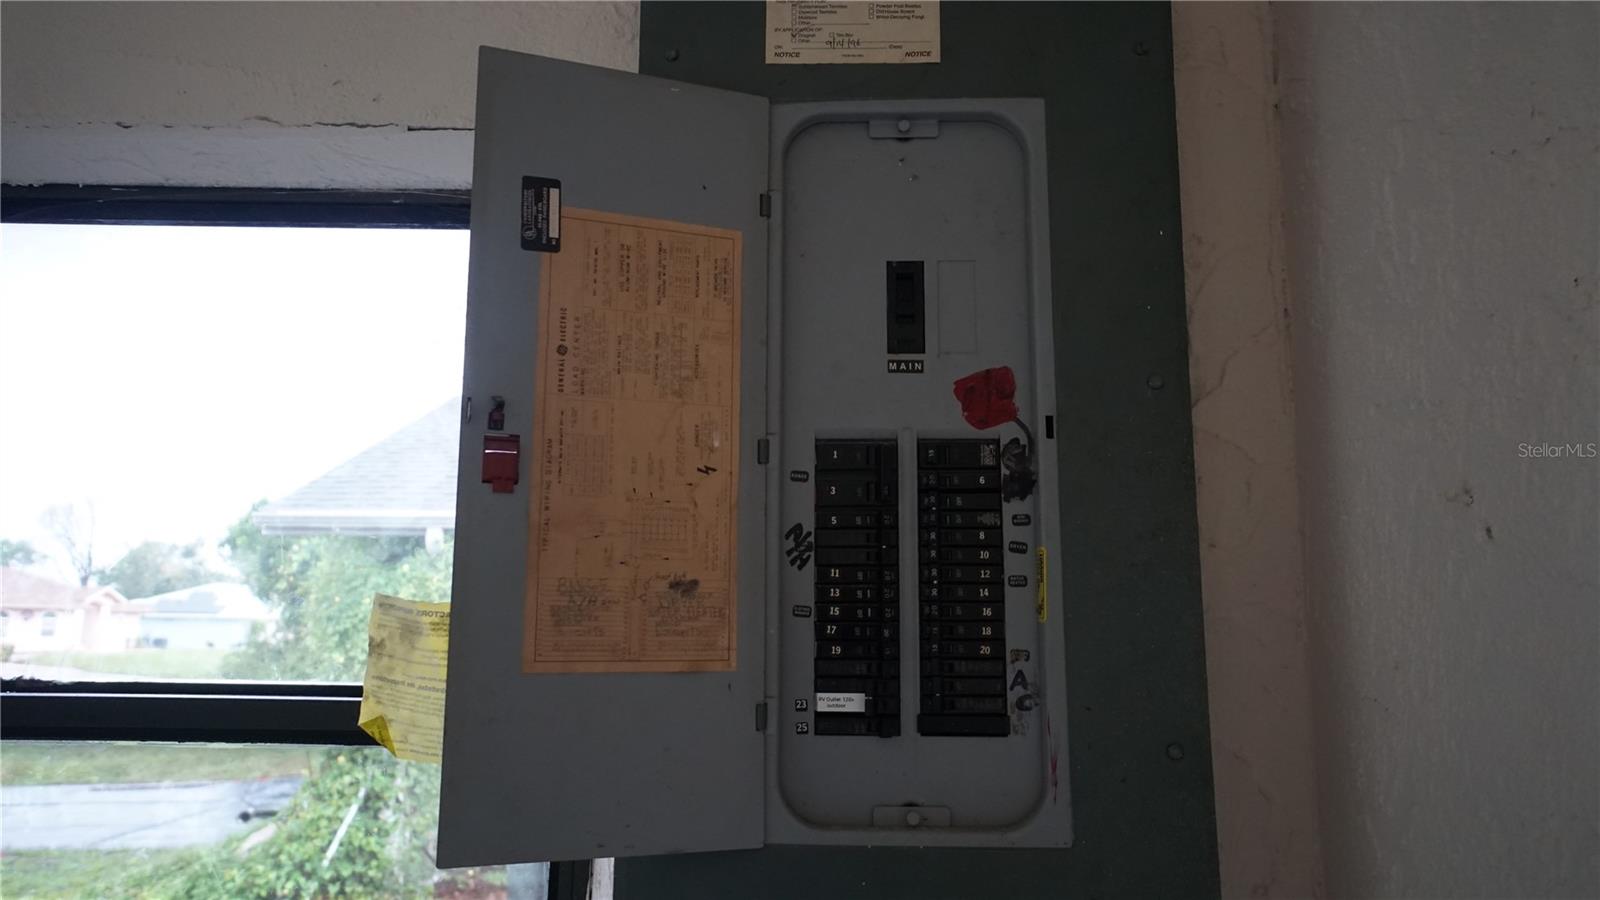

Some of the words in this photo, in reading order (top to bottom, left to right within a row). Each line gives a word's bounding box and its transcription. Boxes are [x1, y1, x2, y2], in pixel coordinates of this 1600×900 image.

[904, 50, 932, 58] NOTICE
[559, 307, 568, 342] ELECTRIC
[572, 316, 581, 359] CENTER
[888, 362, 922, 371] MAIN
[557, 358, 565, 393] GENERAL
[833, 449, 838, 459] 1
[979, 476, 985, 484] 6
[830, 486, 836, 495] 3
[831, 516, 837, 525] 5
[542, 518, 551, 552] TYPICAL
[979, 531, 985, 540] 8
[979, 551, 990, 559] 10
[830, 568, 840, 577] 11
[980, 570, 990, 578] 12
[829, 588, 840, 597] 13
[979, 589, 989, 597] 14
[829, 607, 840, 616] 15
[982, 607, 992, 617] 16
[826, 625, 837, 634] 17
[981, 627, 992, 635] 18
[831, 646, 841, 655] 19
[979, 646, 991, 655] 20
[1009, 669, 1027, 691] A
[795, 700, 807, 709] 23
[796, 723, 808, 732] 25
